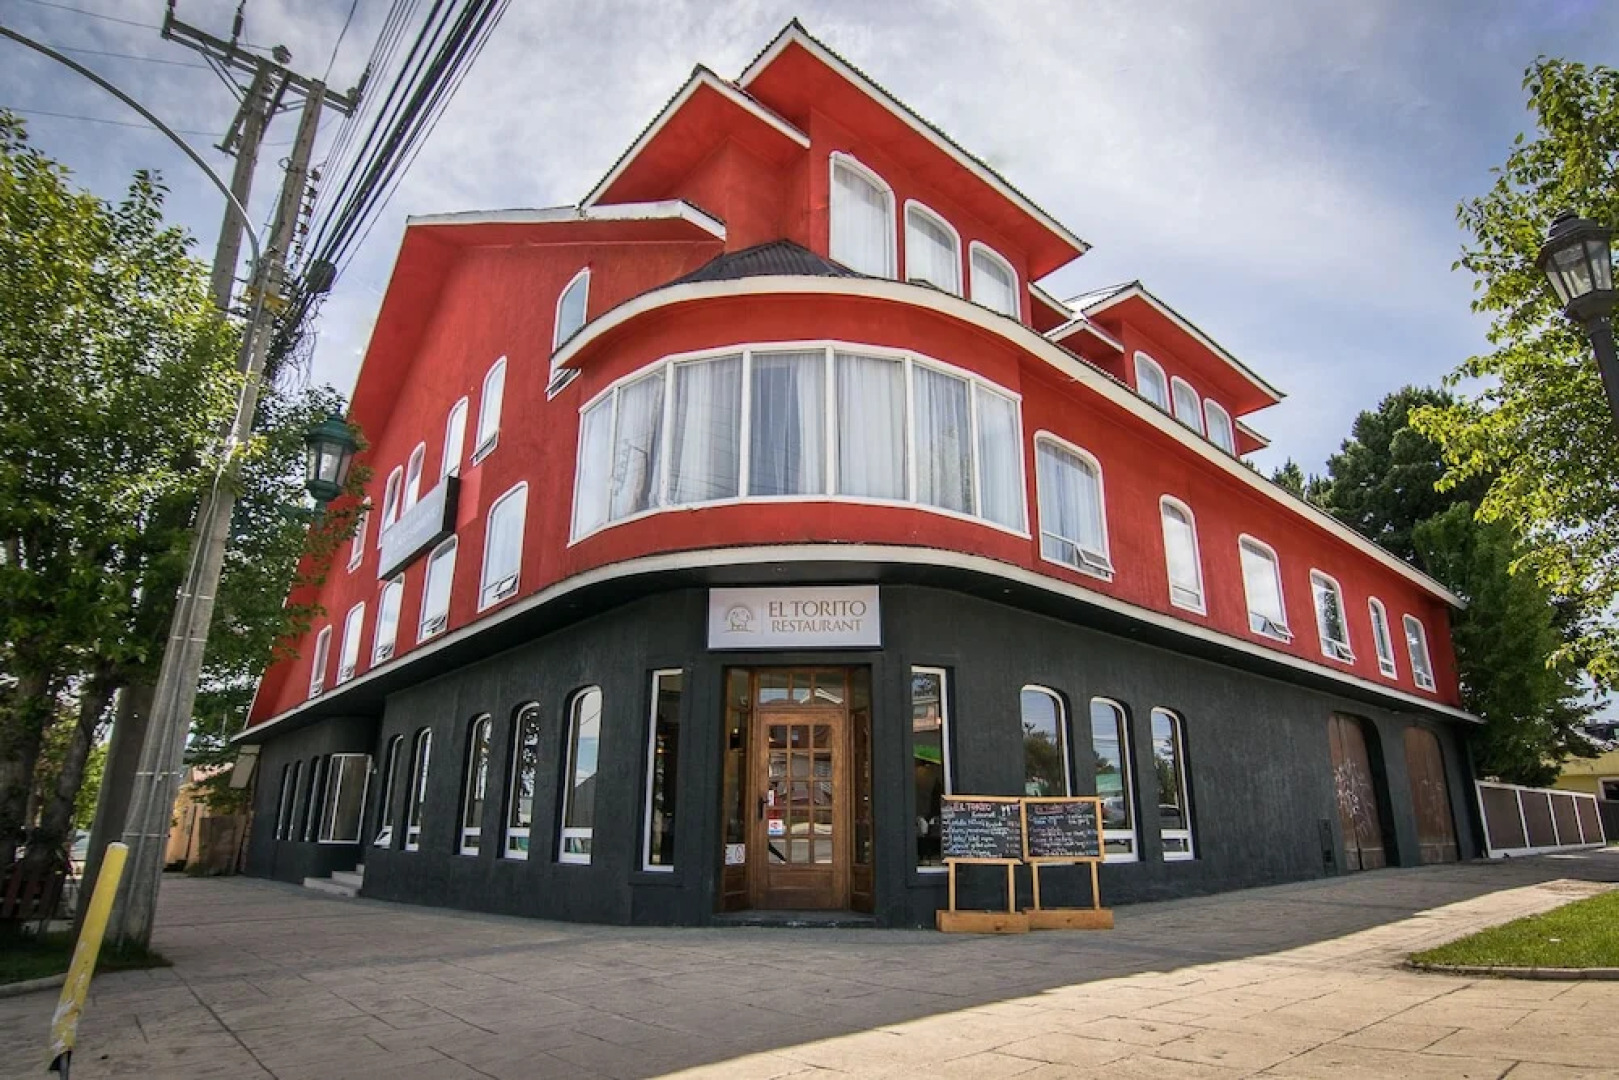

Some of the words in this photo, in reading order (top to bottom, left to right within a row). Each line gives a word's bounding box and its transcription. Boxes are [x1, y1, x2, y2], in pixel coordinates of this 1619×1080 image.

[768, 601, 787, 617] EL
[790, 600, 867, 617] TORITO
[771, 620, 862, 632] RESTAURANT
